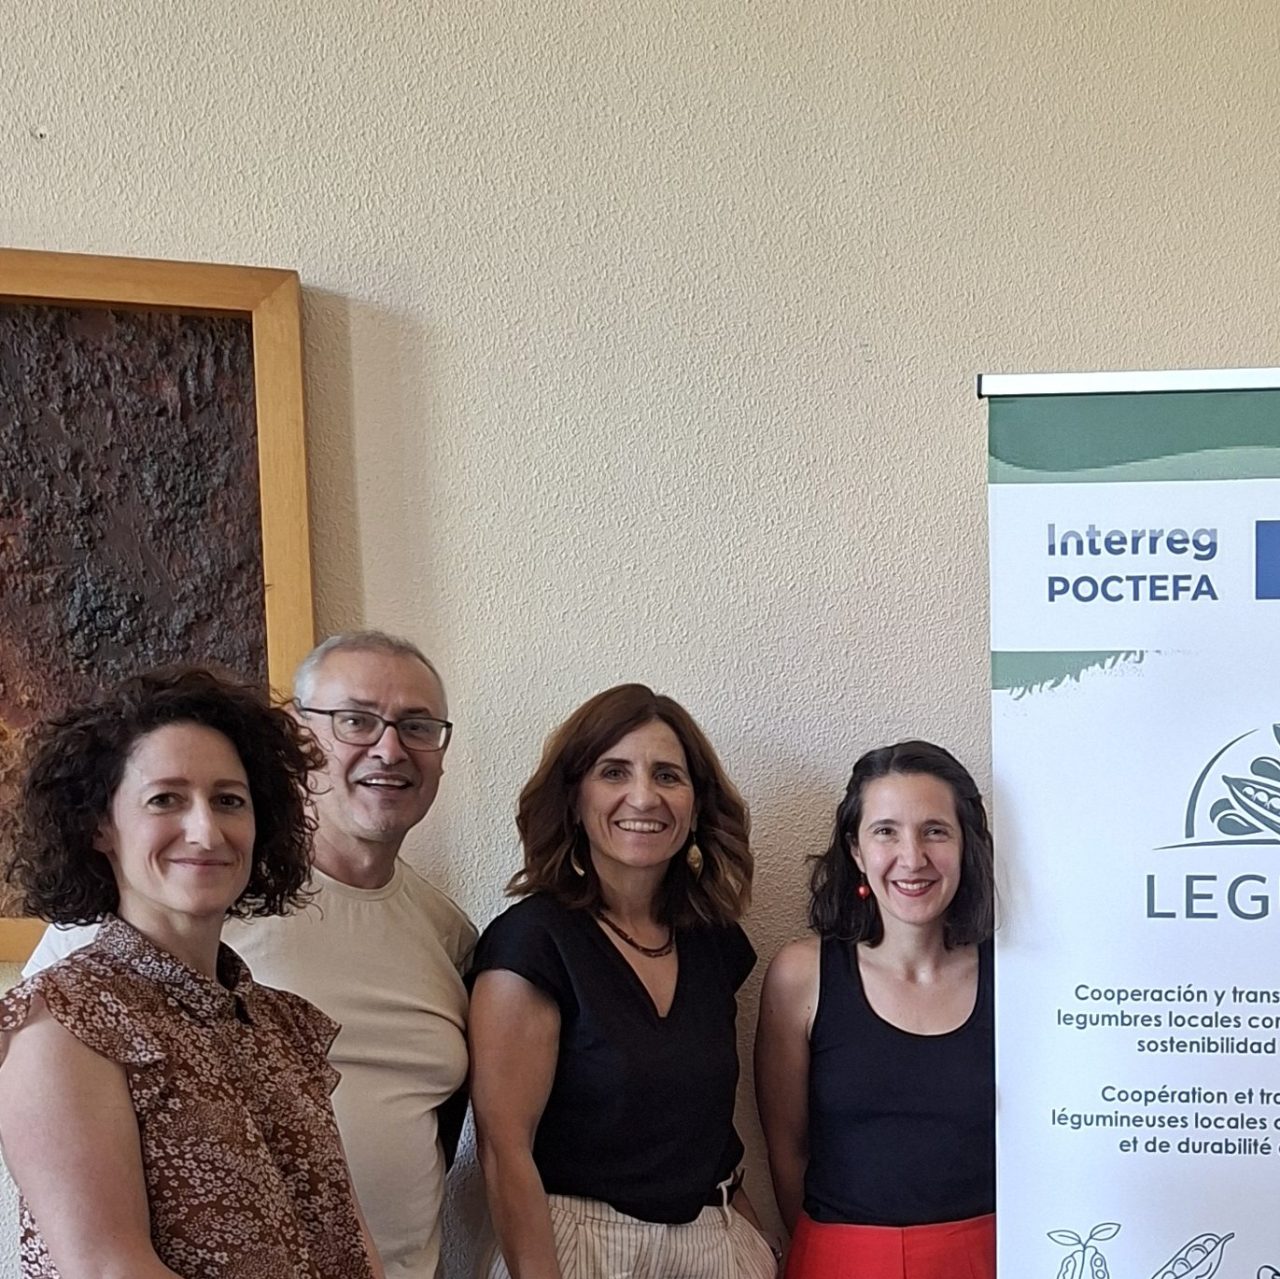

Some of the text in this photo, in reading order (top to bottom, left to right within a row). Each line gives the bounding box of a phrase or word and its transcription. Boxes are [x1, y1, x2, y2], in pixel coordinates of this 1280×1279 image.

[1047, 523, 1218, 562] Interreg
[1047, 574, 1219, 603] POCTEFA
[1074, 983, 1208, 1006] Cooperación
[1213, 989, 1226, 1007] y
[1057, 1009, 1163, 1032] legumbres
[1168, 1010, 1242, 1029] locales
[1137, 1036, 1276, 1055] sostenibilidad
[1101, 1084, 1228, 1107] Coopération
[1234, 1087, 1254, 1105] et
[1051, 1107, 1189, 1130] légumineuses
[1194, 1111, 1268, 1130] locales
[1119, 1136, 1139, 1153] et
[1144, 1136, 1171, 1154] de
[1177, 1136, 1272, 1156] durabilité
